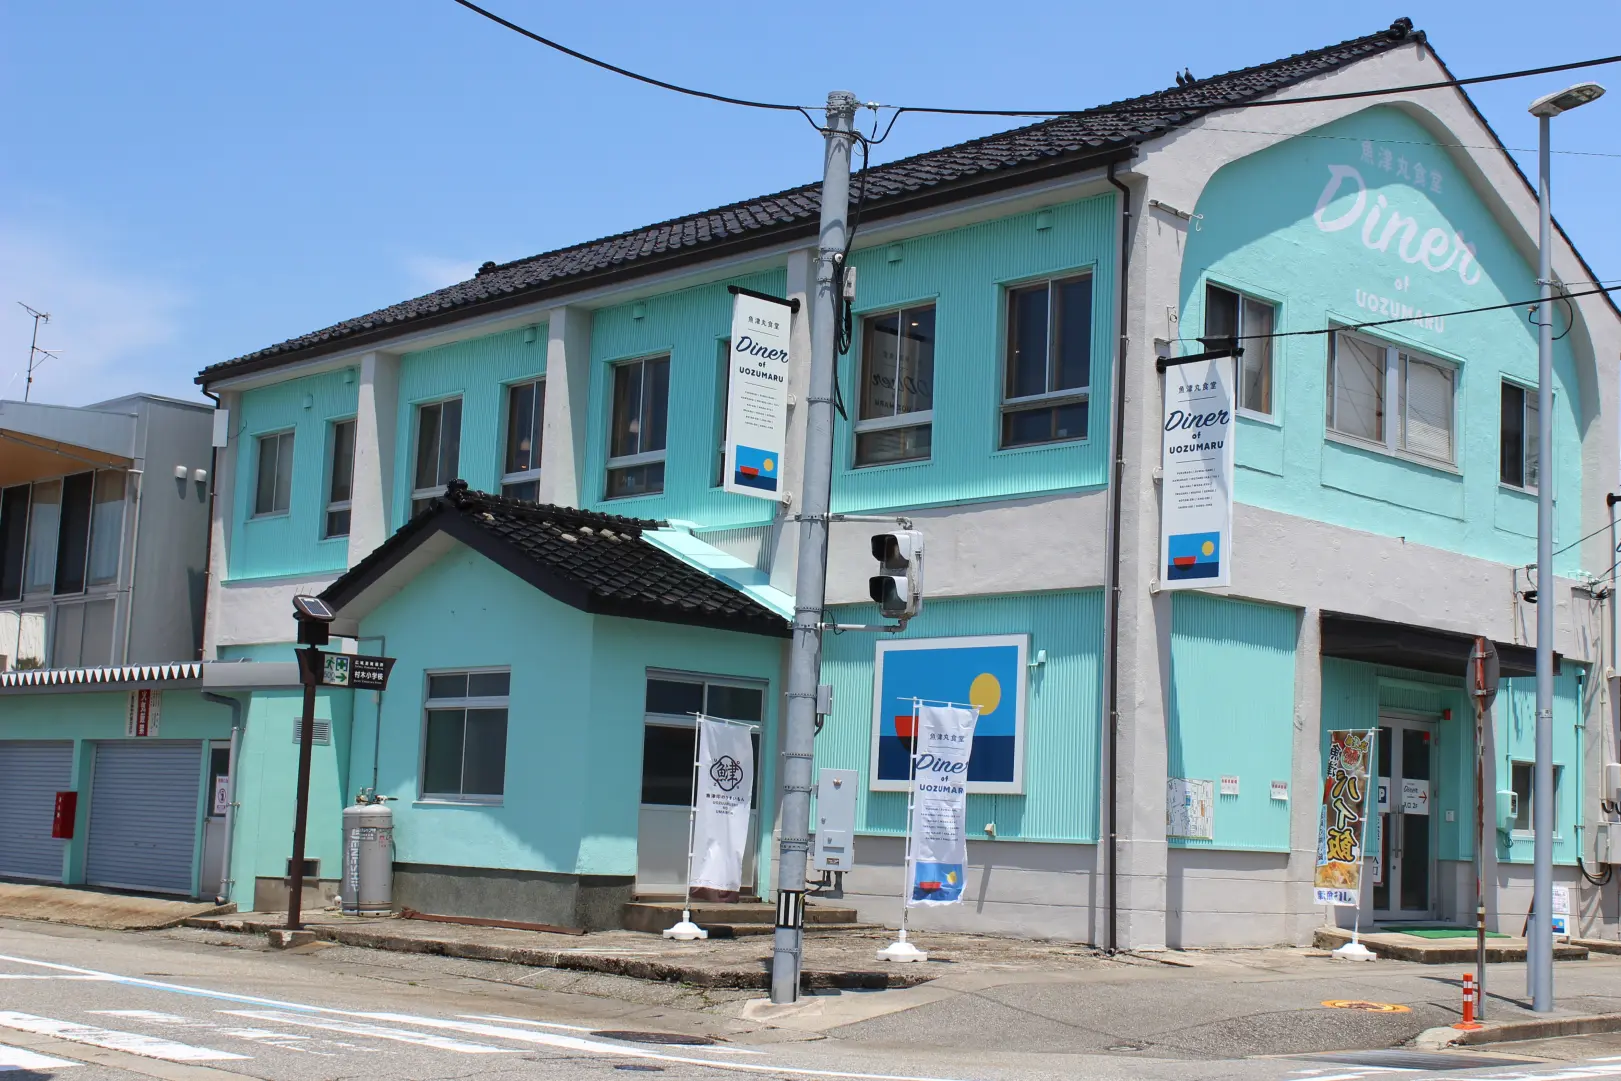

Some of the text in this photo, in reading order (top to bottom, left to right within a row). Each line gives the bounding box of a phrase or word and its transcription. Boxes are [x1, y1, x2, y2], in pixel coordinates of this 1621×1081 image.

[1361, 140, 1443, 194] 魚津丸食堂
[1313, 165, 1481, 285] Diner
[1394, 275, 1409, 292] of
[1356, 289, 1444, 333] UOZUMARU
[748, 315, 780, 330] 魚津丸食堂
[735, 336, 789, 363] Diner
[739, 366, 784, 383] UOZUMARU
[1178, 381, 1217, 394] 魚津丸食堂
[1164, 409, 1230, 431] Diner
[1192, 431, 1201, 439] of
[1169, 440, 1224, 454] UOZUMARU
[354, 670, 384, 681] 村木小学校
[929, 733, 965, 742] 魚津丸食堂
